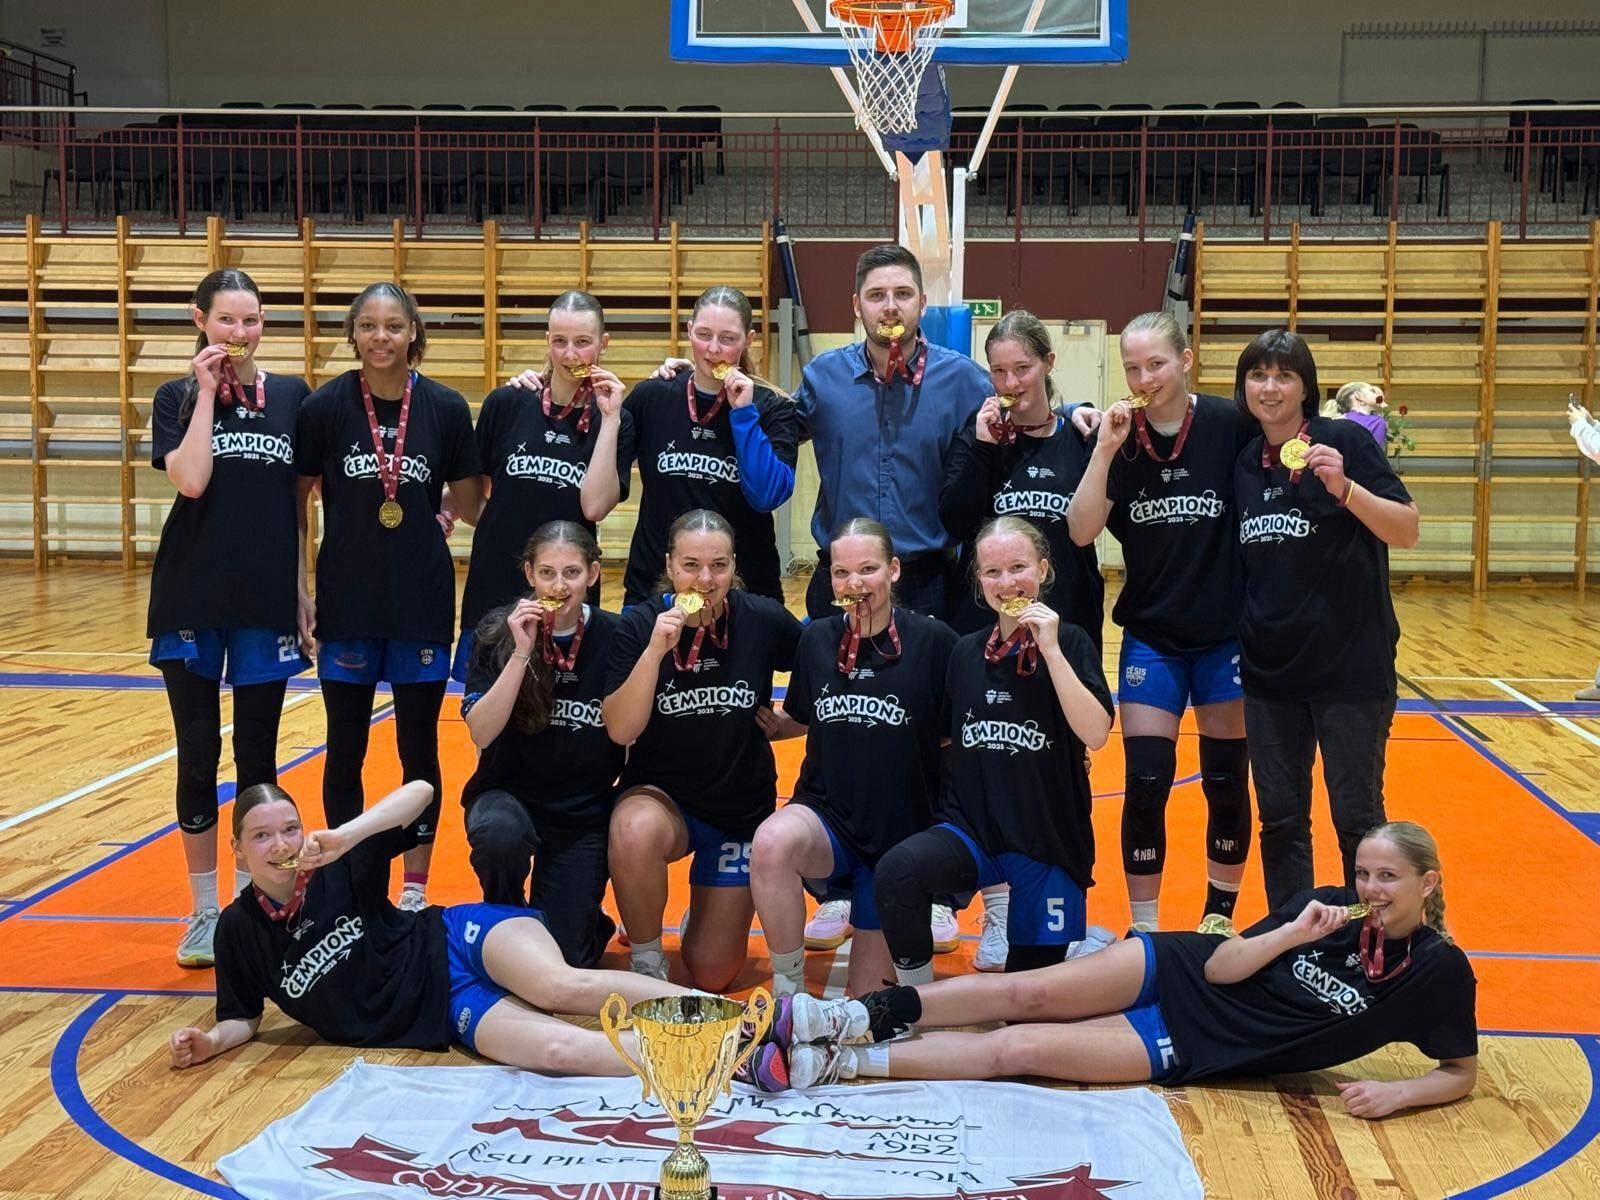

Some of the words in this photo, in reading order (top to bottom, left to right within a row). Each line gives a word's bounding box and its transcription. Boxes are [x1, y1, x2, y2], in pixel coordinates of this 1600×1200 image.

[243, 452, 260, 460] 2025
[506, 453, 587, 489] ČEMPION
[537, 475, 553, 484] 2025
[687, 472, 703, 480] 2025
[1028, 510, 1046, 518] 2025
[1167, 516, 1184, 524] 2025
[697, 707, 715, 715] 2025
[550, 719, 567, 727] 2025
[987, 742, 1005, 751] 2025
[718, 842, 753, 873] 25
[1140, 847, 1157, 861] NBA
[1046, 897, 1065, 931] 5
[320, 958, 338, 975] 2025
[868, 1131, 958, 1143] ANNO
[864, 1140, 957, 1156] 1952
